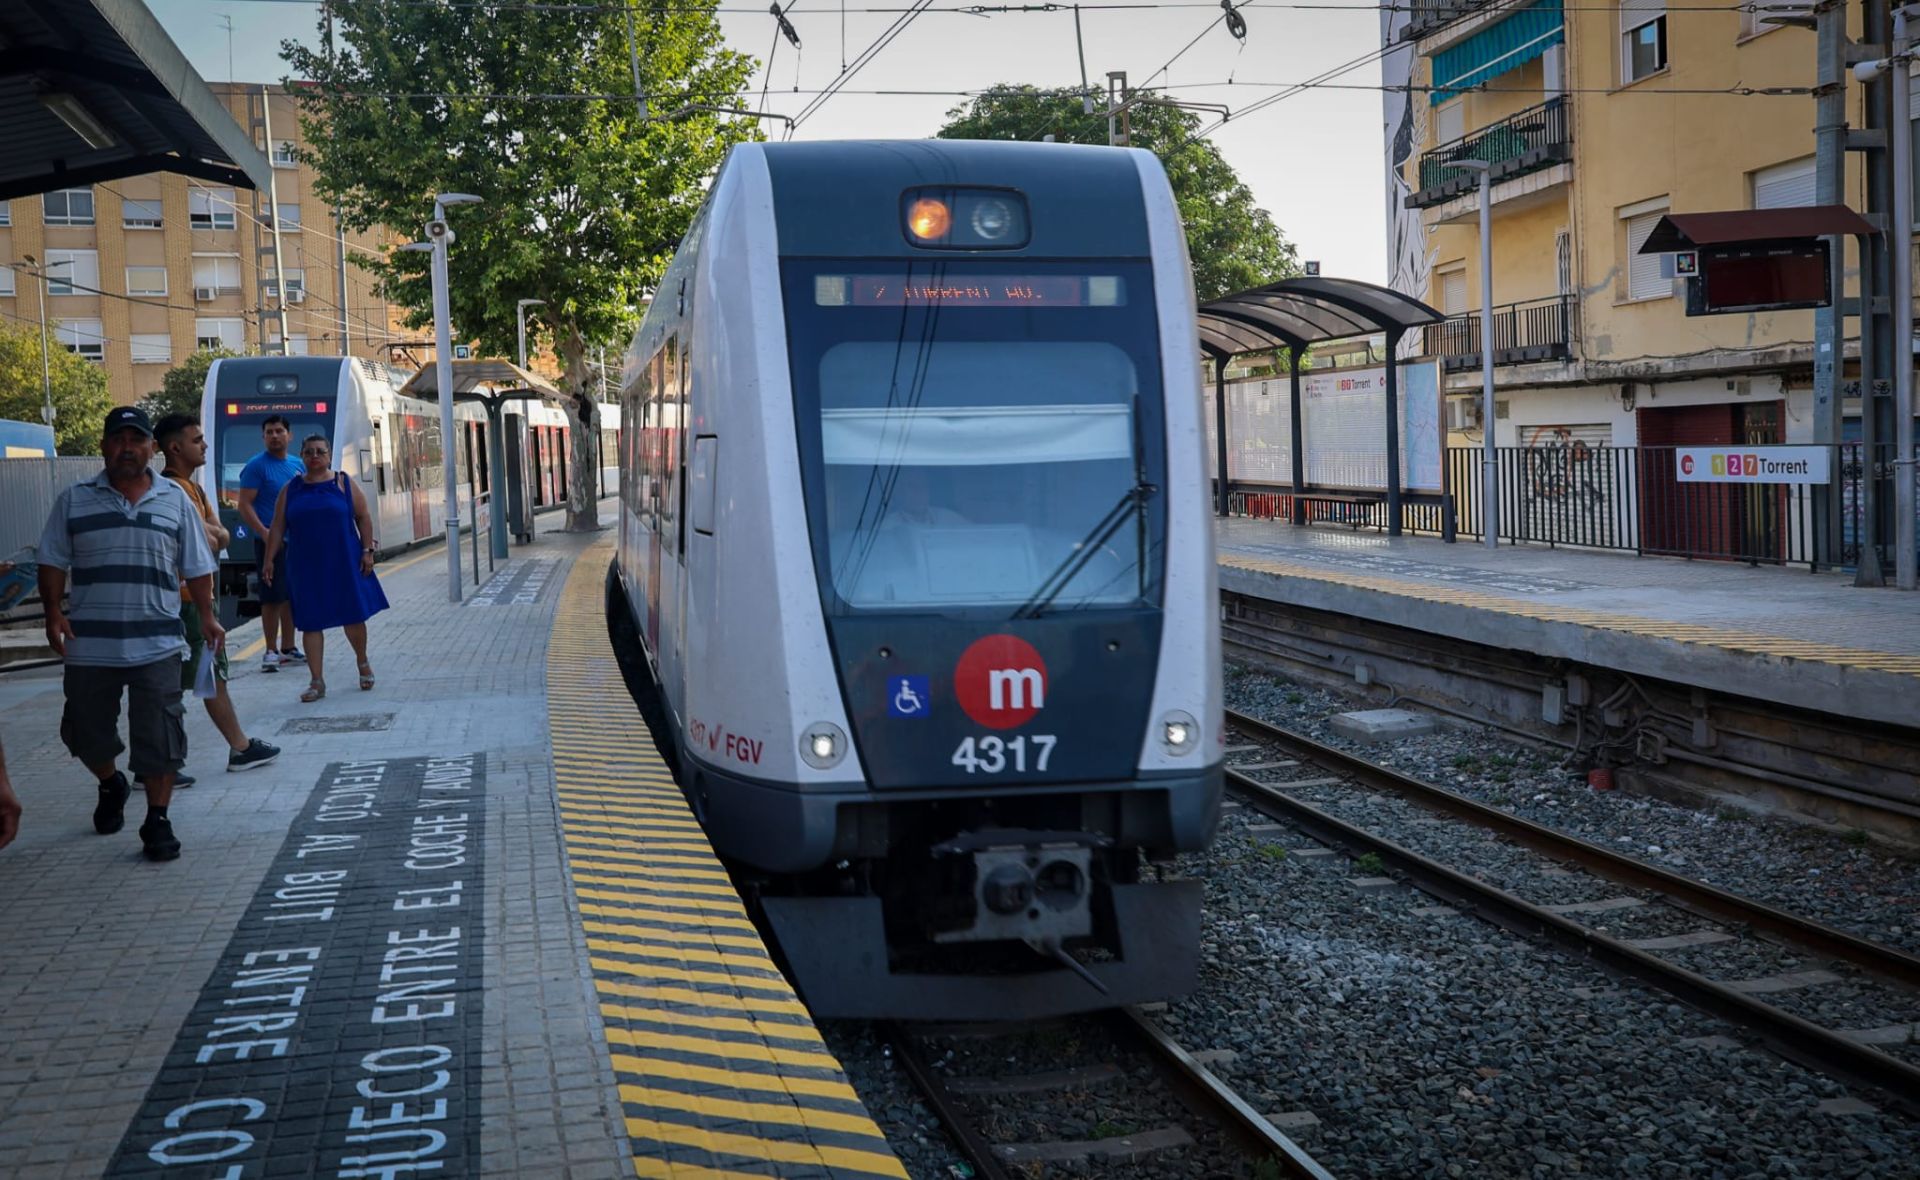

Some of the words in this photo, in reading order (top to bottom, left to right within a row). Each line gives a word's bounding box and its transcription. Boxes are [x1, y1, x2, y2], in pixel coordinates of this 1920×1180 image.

[1759, 458, 1808, 475] Torrent
[988, 667, 1044, 710] m
[725, 732, 764, 765] FGV
[951, 734, 1057, 774] 4317
[314, 759, 388, 823] ATENCIÓ
[417, 798, 471, 809] Y
[296, 834, 361, 860] AL
[403, 812, 469, 871] COCHE
[263, 869, 348, 923] BUIT
[393, 880, 463, 912] EL
[371, 925, 461, 1025] ENTRE
[196, 946, 321, 1064] ENTRE
